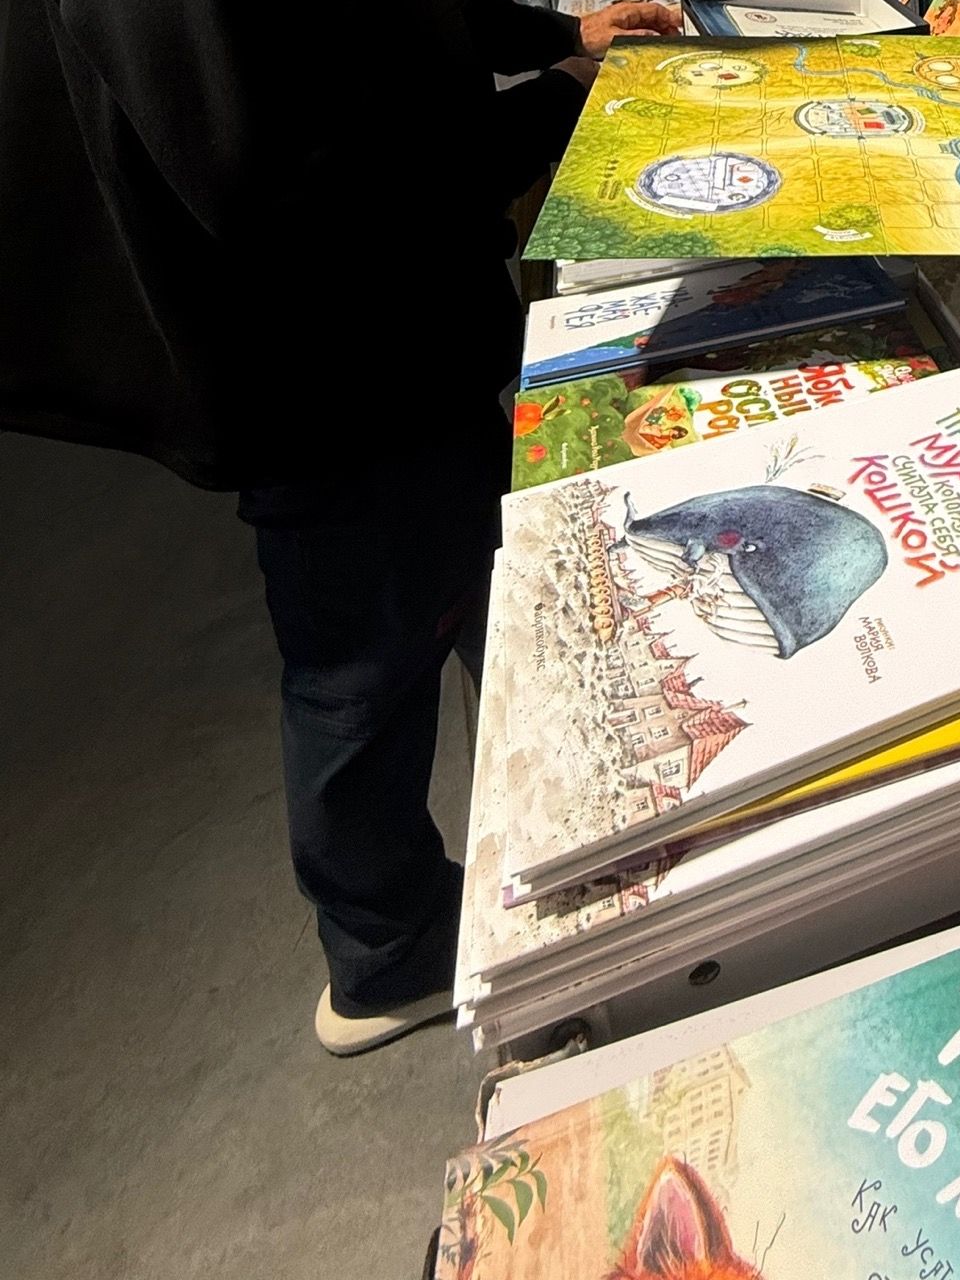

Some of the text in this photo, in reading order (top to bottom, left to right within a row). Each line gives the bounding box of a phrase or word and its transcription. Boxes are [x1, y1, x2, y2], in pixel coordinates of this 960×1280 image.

[891, 455, 938, 515] СЧИТАЛА
[531, 611, 548, 672] абрикобукс
[853, 633, 882, 684] ВОЛКОВА
[858, 616, 884, 652] МАРИЯ
